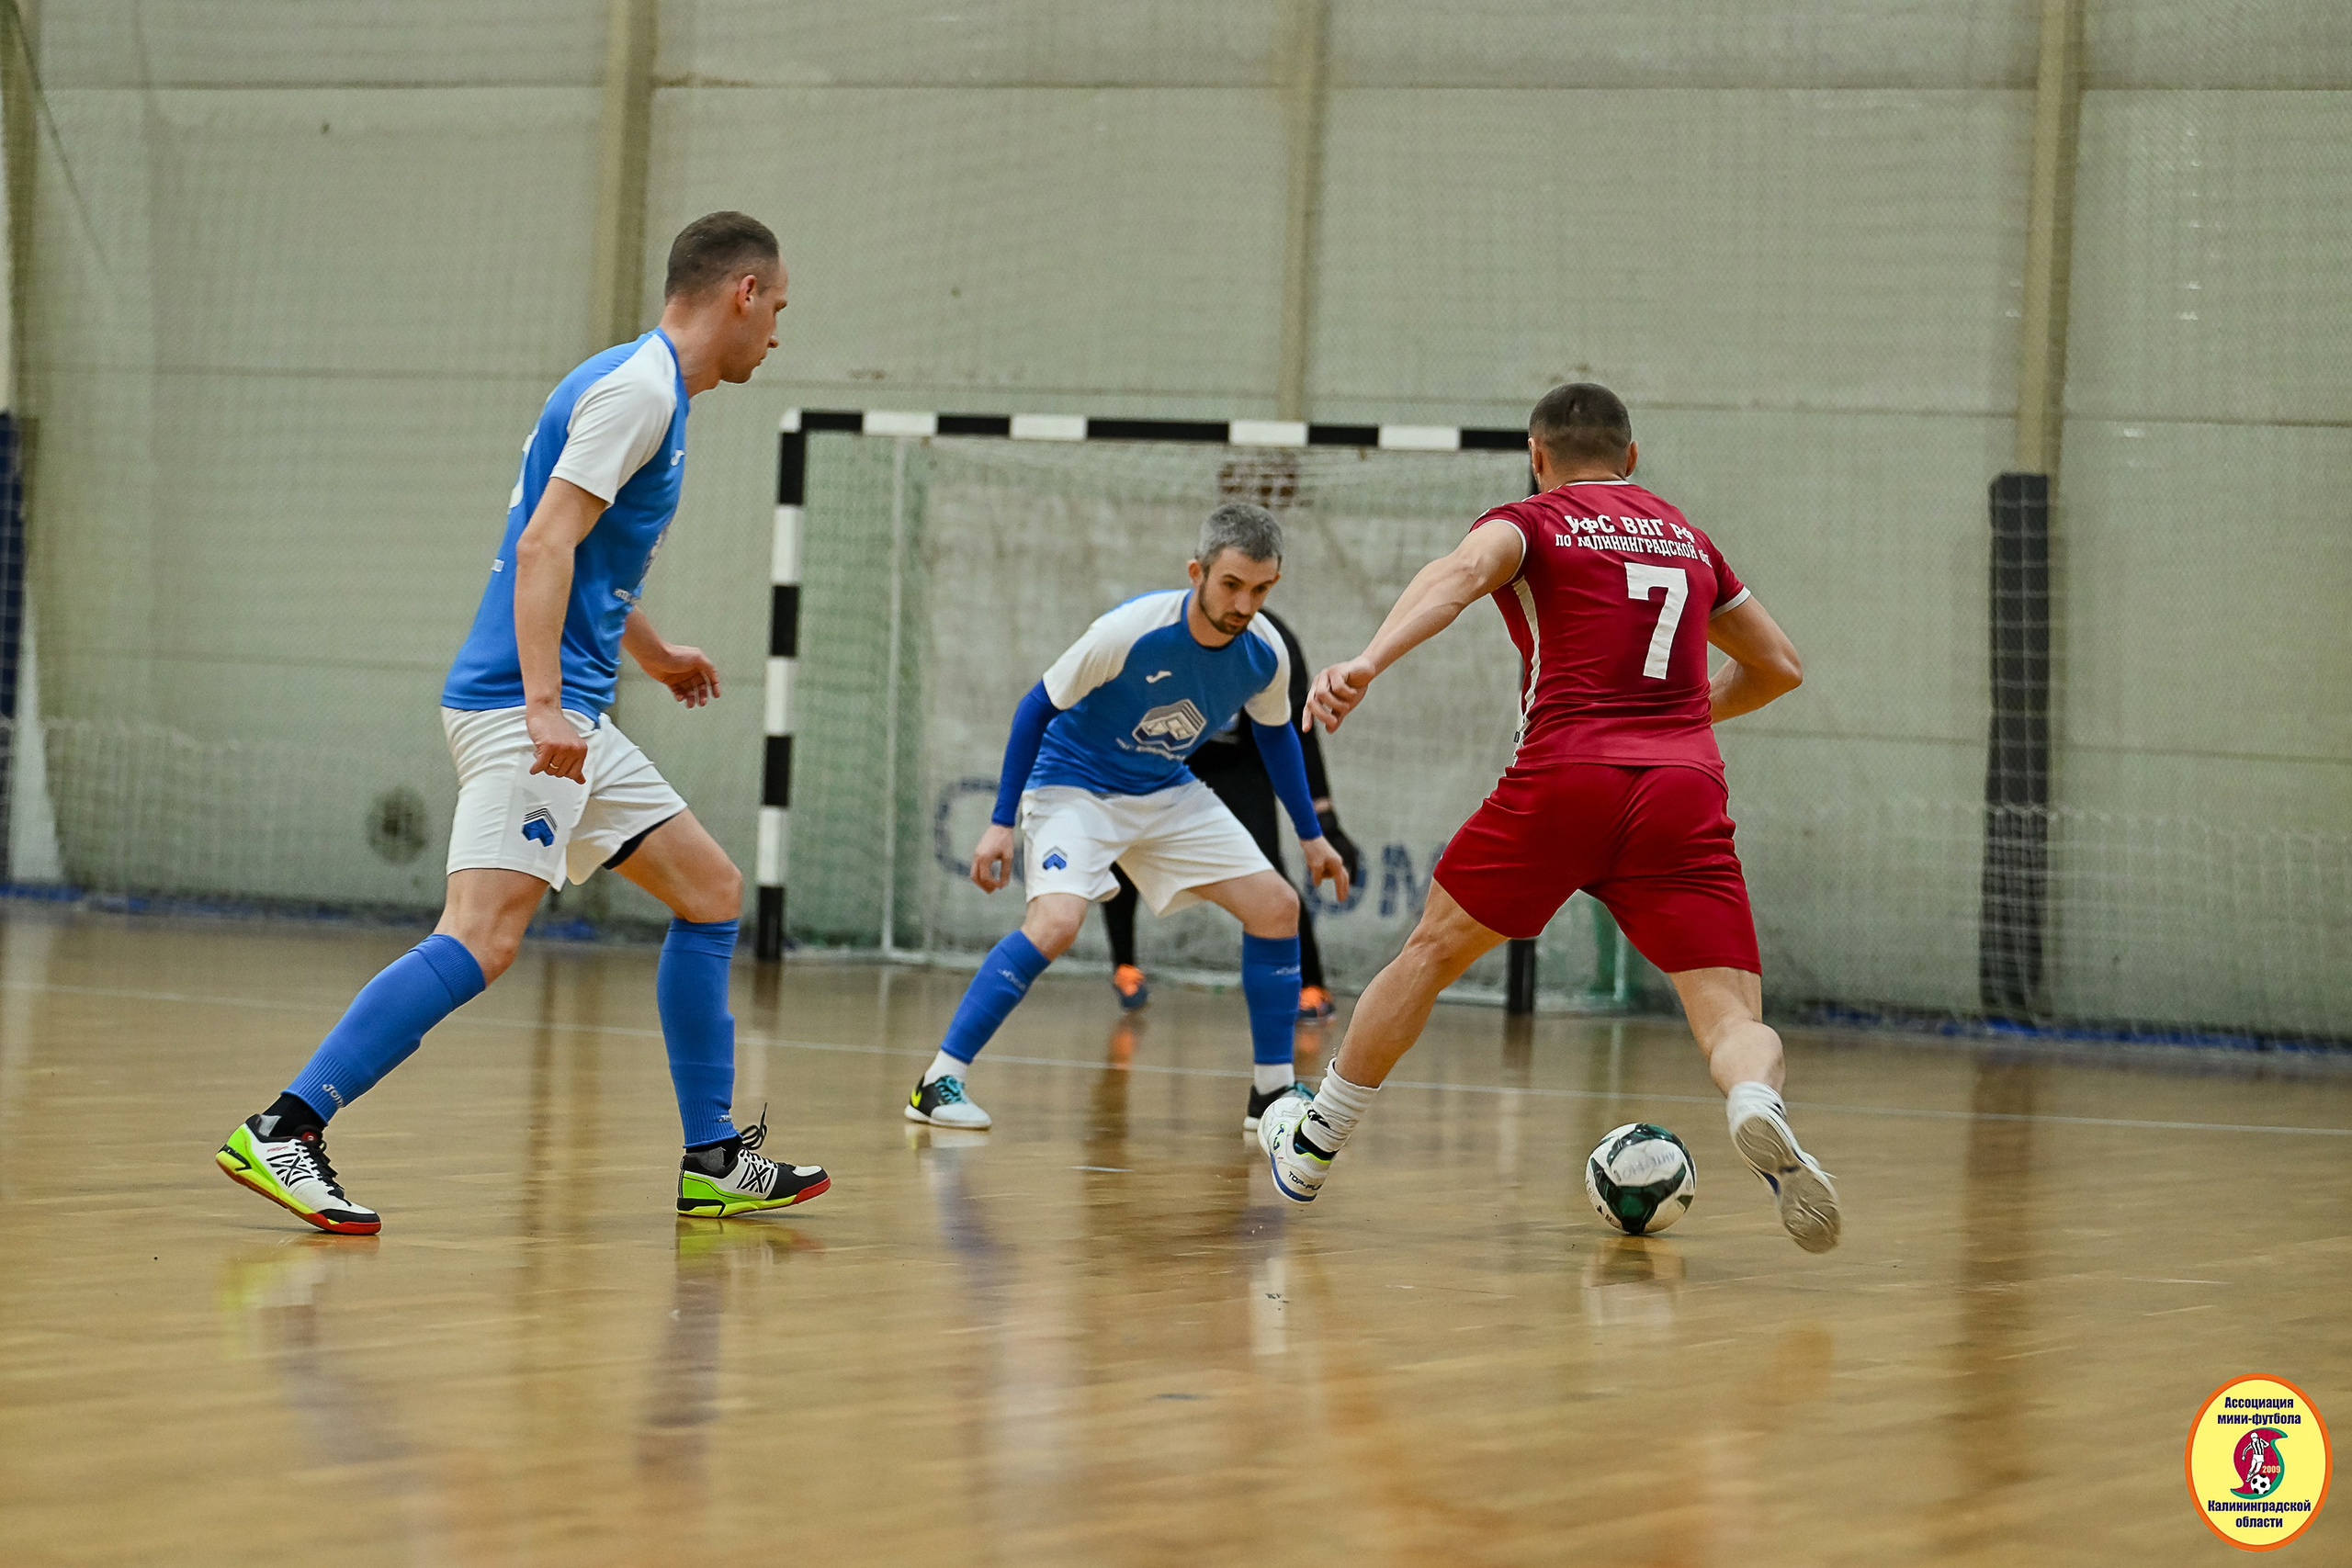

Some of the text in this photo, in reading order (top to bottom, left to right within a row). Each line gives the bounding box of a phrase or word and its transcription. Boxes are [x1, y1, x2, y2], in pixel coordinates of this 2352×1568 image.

[1564, 514, 1696, 543] УФС ВНГ РФ
[1555, 534, 1572, 547] ПО
[1577, 535, 1699, 560] КАЛИНИНГРАДСКОЙ
[1624, 561, 1689, 680] 7
